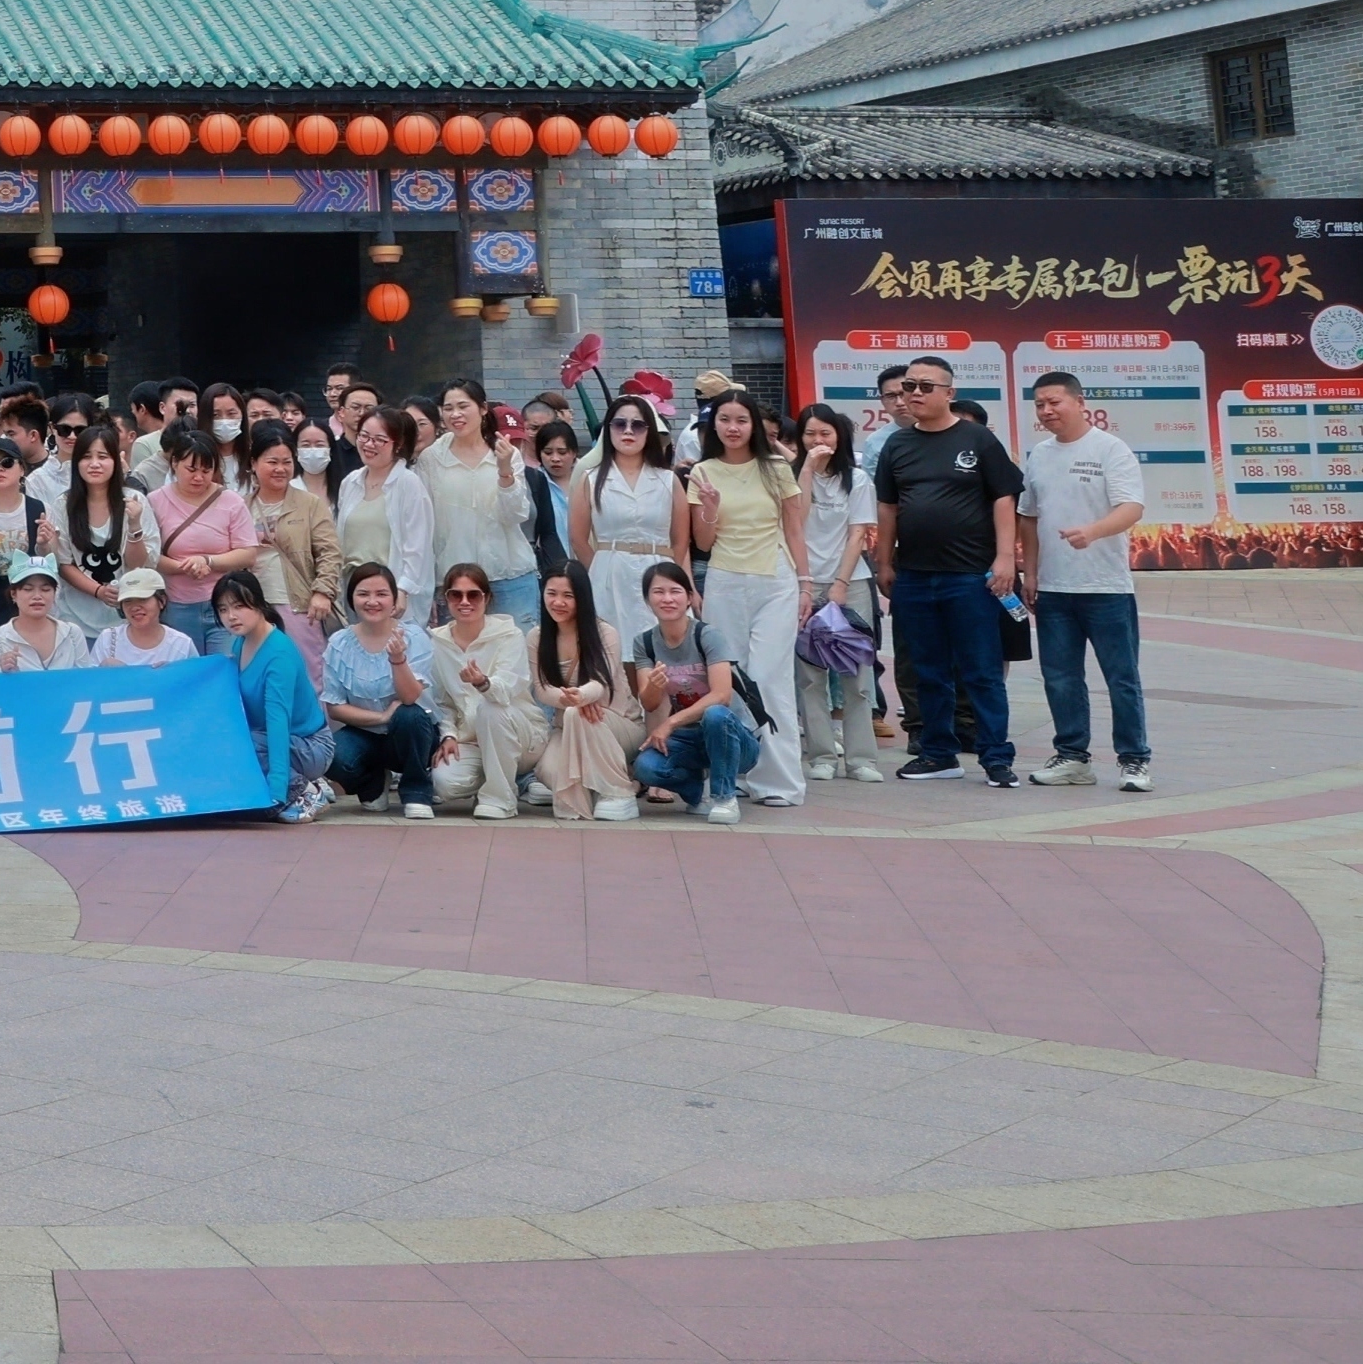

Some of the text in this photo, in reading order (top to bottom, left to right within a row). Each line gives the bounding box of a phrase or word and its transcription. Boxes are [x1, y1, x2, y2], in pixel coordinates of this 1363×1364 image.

[804, 227, 883, 239] 广州融创文旅城
[695, 281, 713, 293] 78
[869, 334, 949, 349] 五一超前预售
[1054, 334, 1161, 348] 五一当期优惠购票
[1236, 333, 1288, 347] 扫码购票
[1261, 383, 1317, 397] 常规购票
[505, 414, 518, 427] LA
